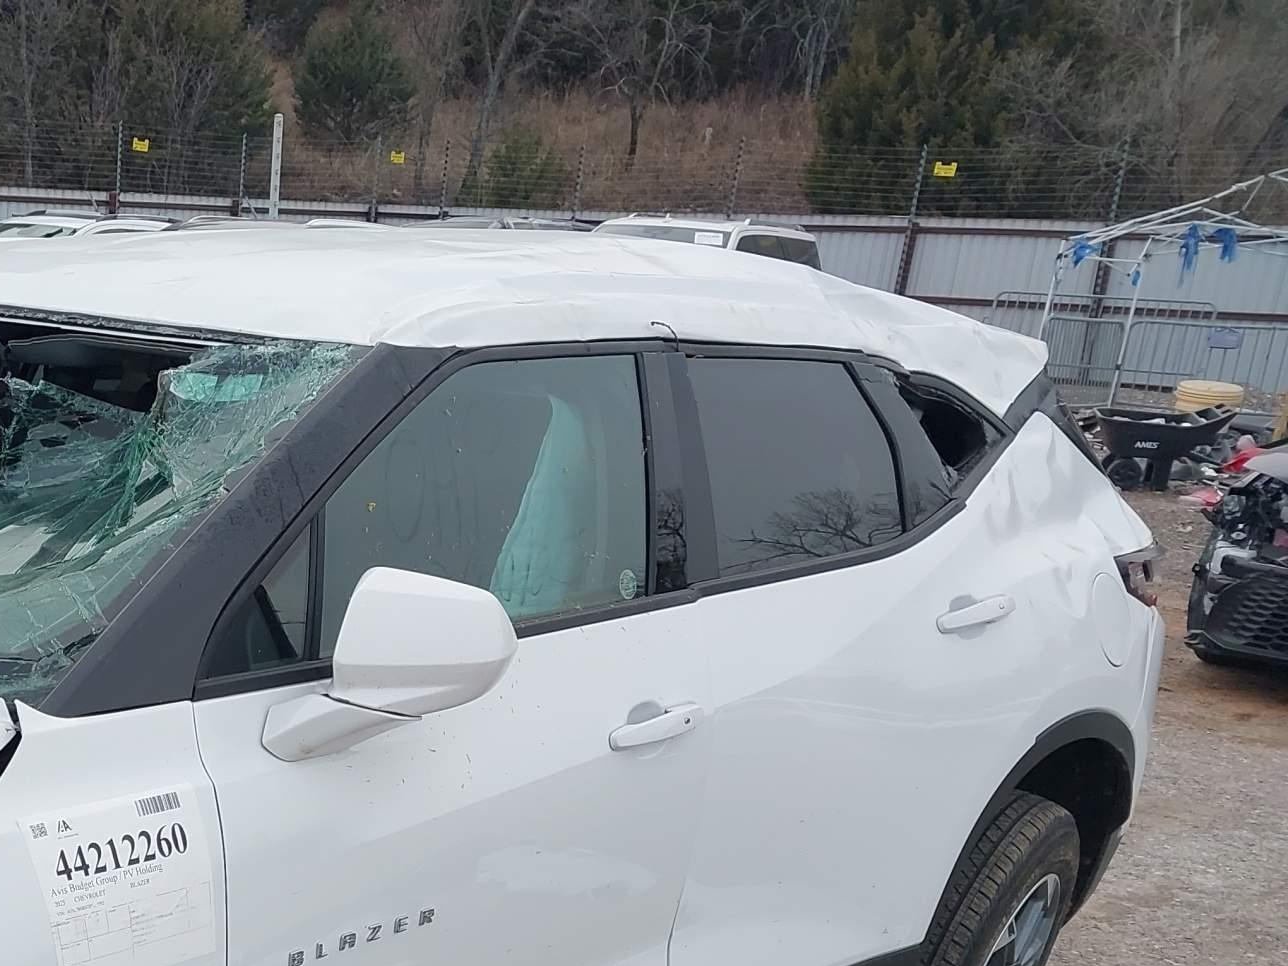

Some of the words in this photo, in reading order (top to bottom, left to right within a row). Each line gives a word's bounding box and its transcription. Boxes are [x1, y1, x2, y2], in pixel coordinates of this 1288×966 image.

[1133, 440, 1161, 449] AMES
[55, 822, 188, 881] 44212260
[51, 886, 69, 898] Avis
[68, 880, 94, 893] Budget
[95, 874, 118, 886] Group
[123, 867, 134, 880] PV
[135, 863, 164, 877] Holding
[73, 889, 106, 903] CHEVROLET
[129, 878, 150, 889] BLAZER
